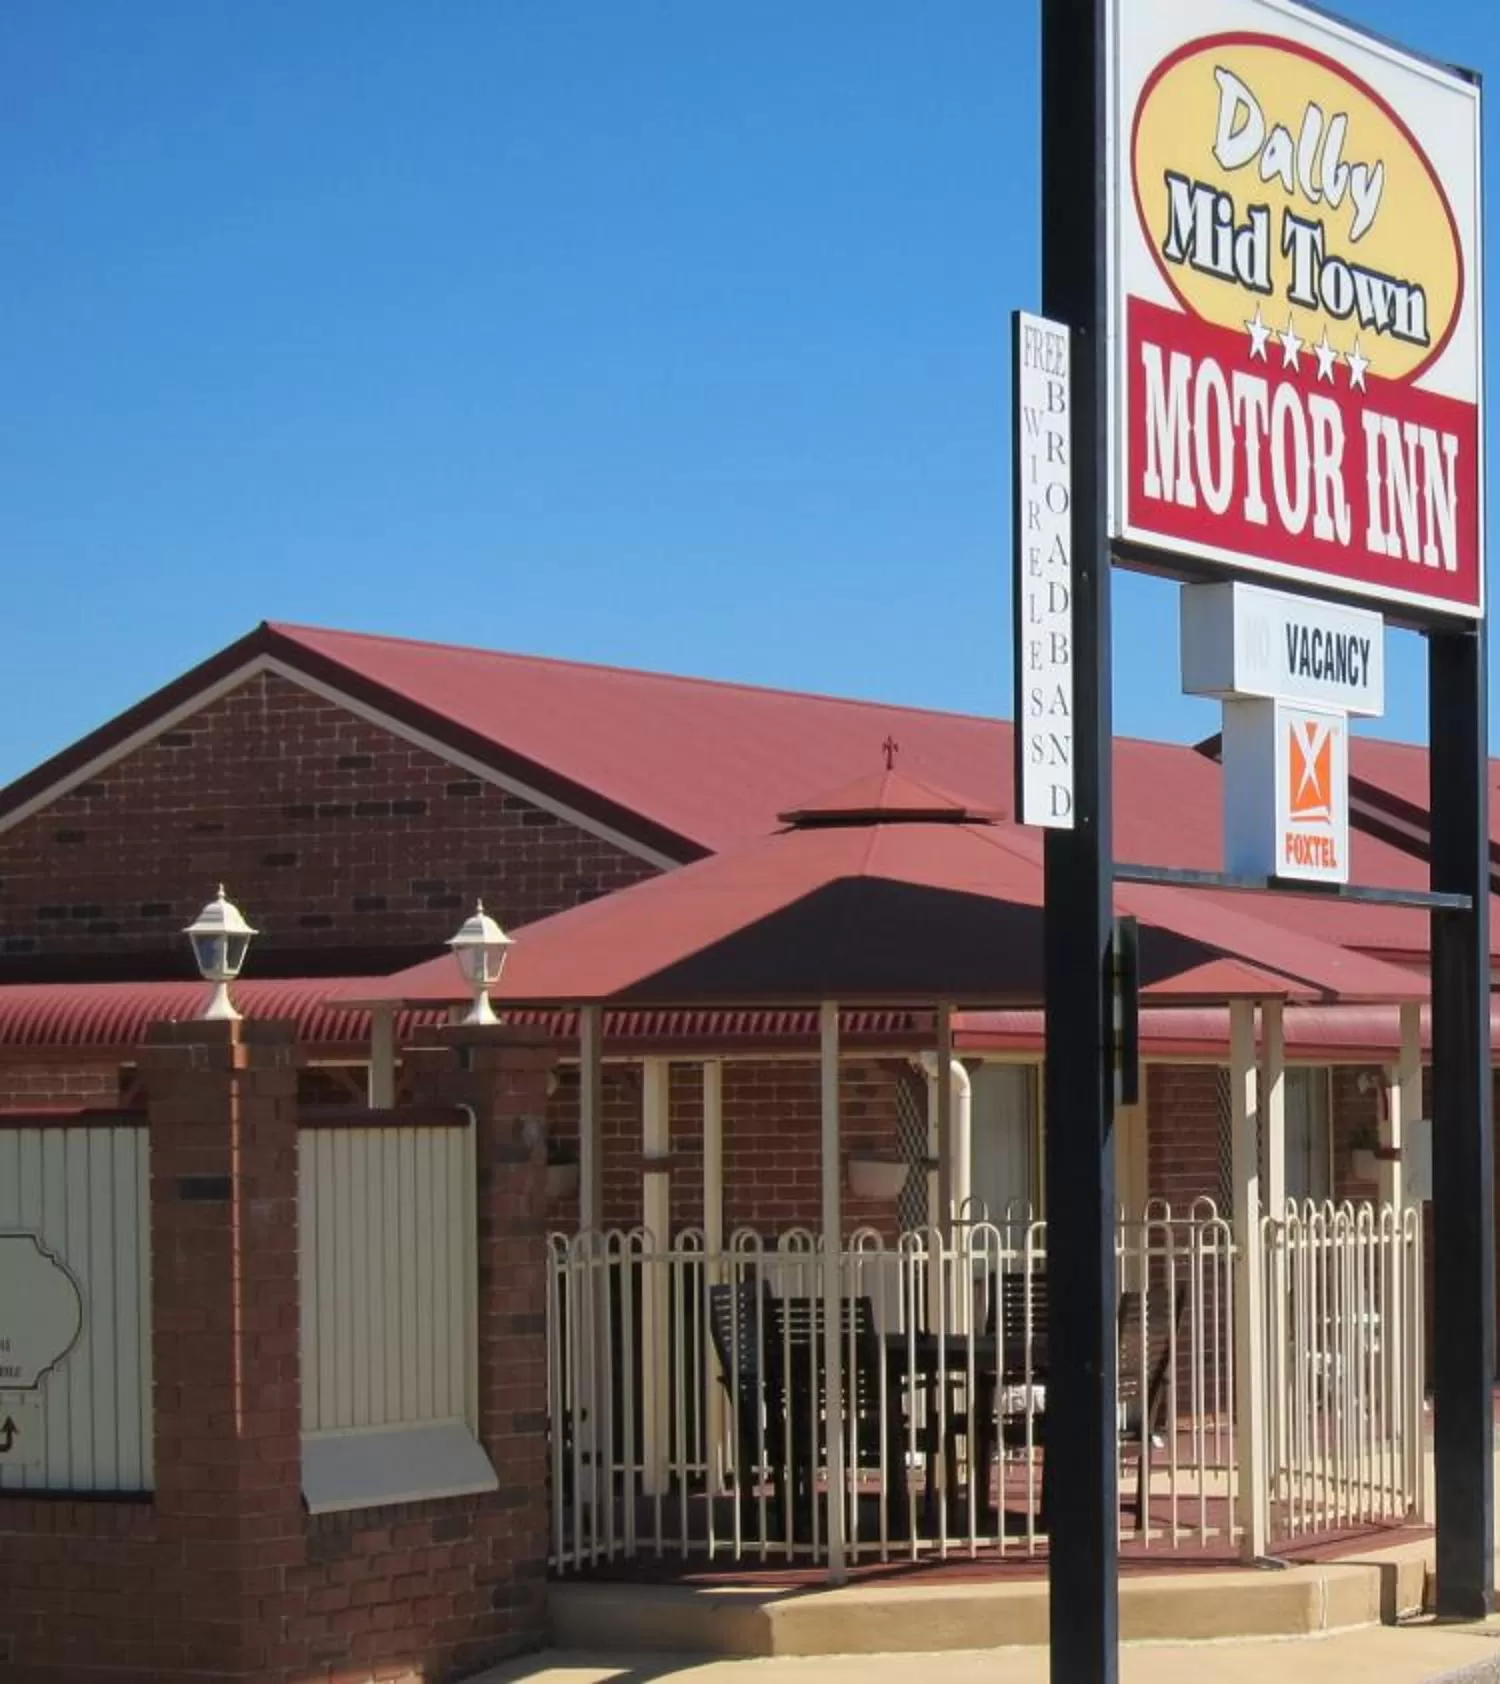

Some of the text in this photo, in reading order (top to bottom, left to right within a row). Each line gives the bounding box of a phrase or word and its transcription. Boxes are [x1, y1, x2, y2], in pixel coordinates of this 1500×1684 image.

[1212, 65, 1384, 243] Dalby
[1163, 169, 1430, 347] Mid Town
[1023, 324, 1066, 379] FREE
[1141, 341, 1458, 572] MOTOR INN
[1023, 405, 1045, 766] WIRELESS
[1045, 380, 1071, 817] BROADBAND
[1286, 621, 1371, 688] VACANCY
[1285, 831, 1338, 869] FOXTEL
